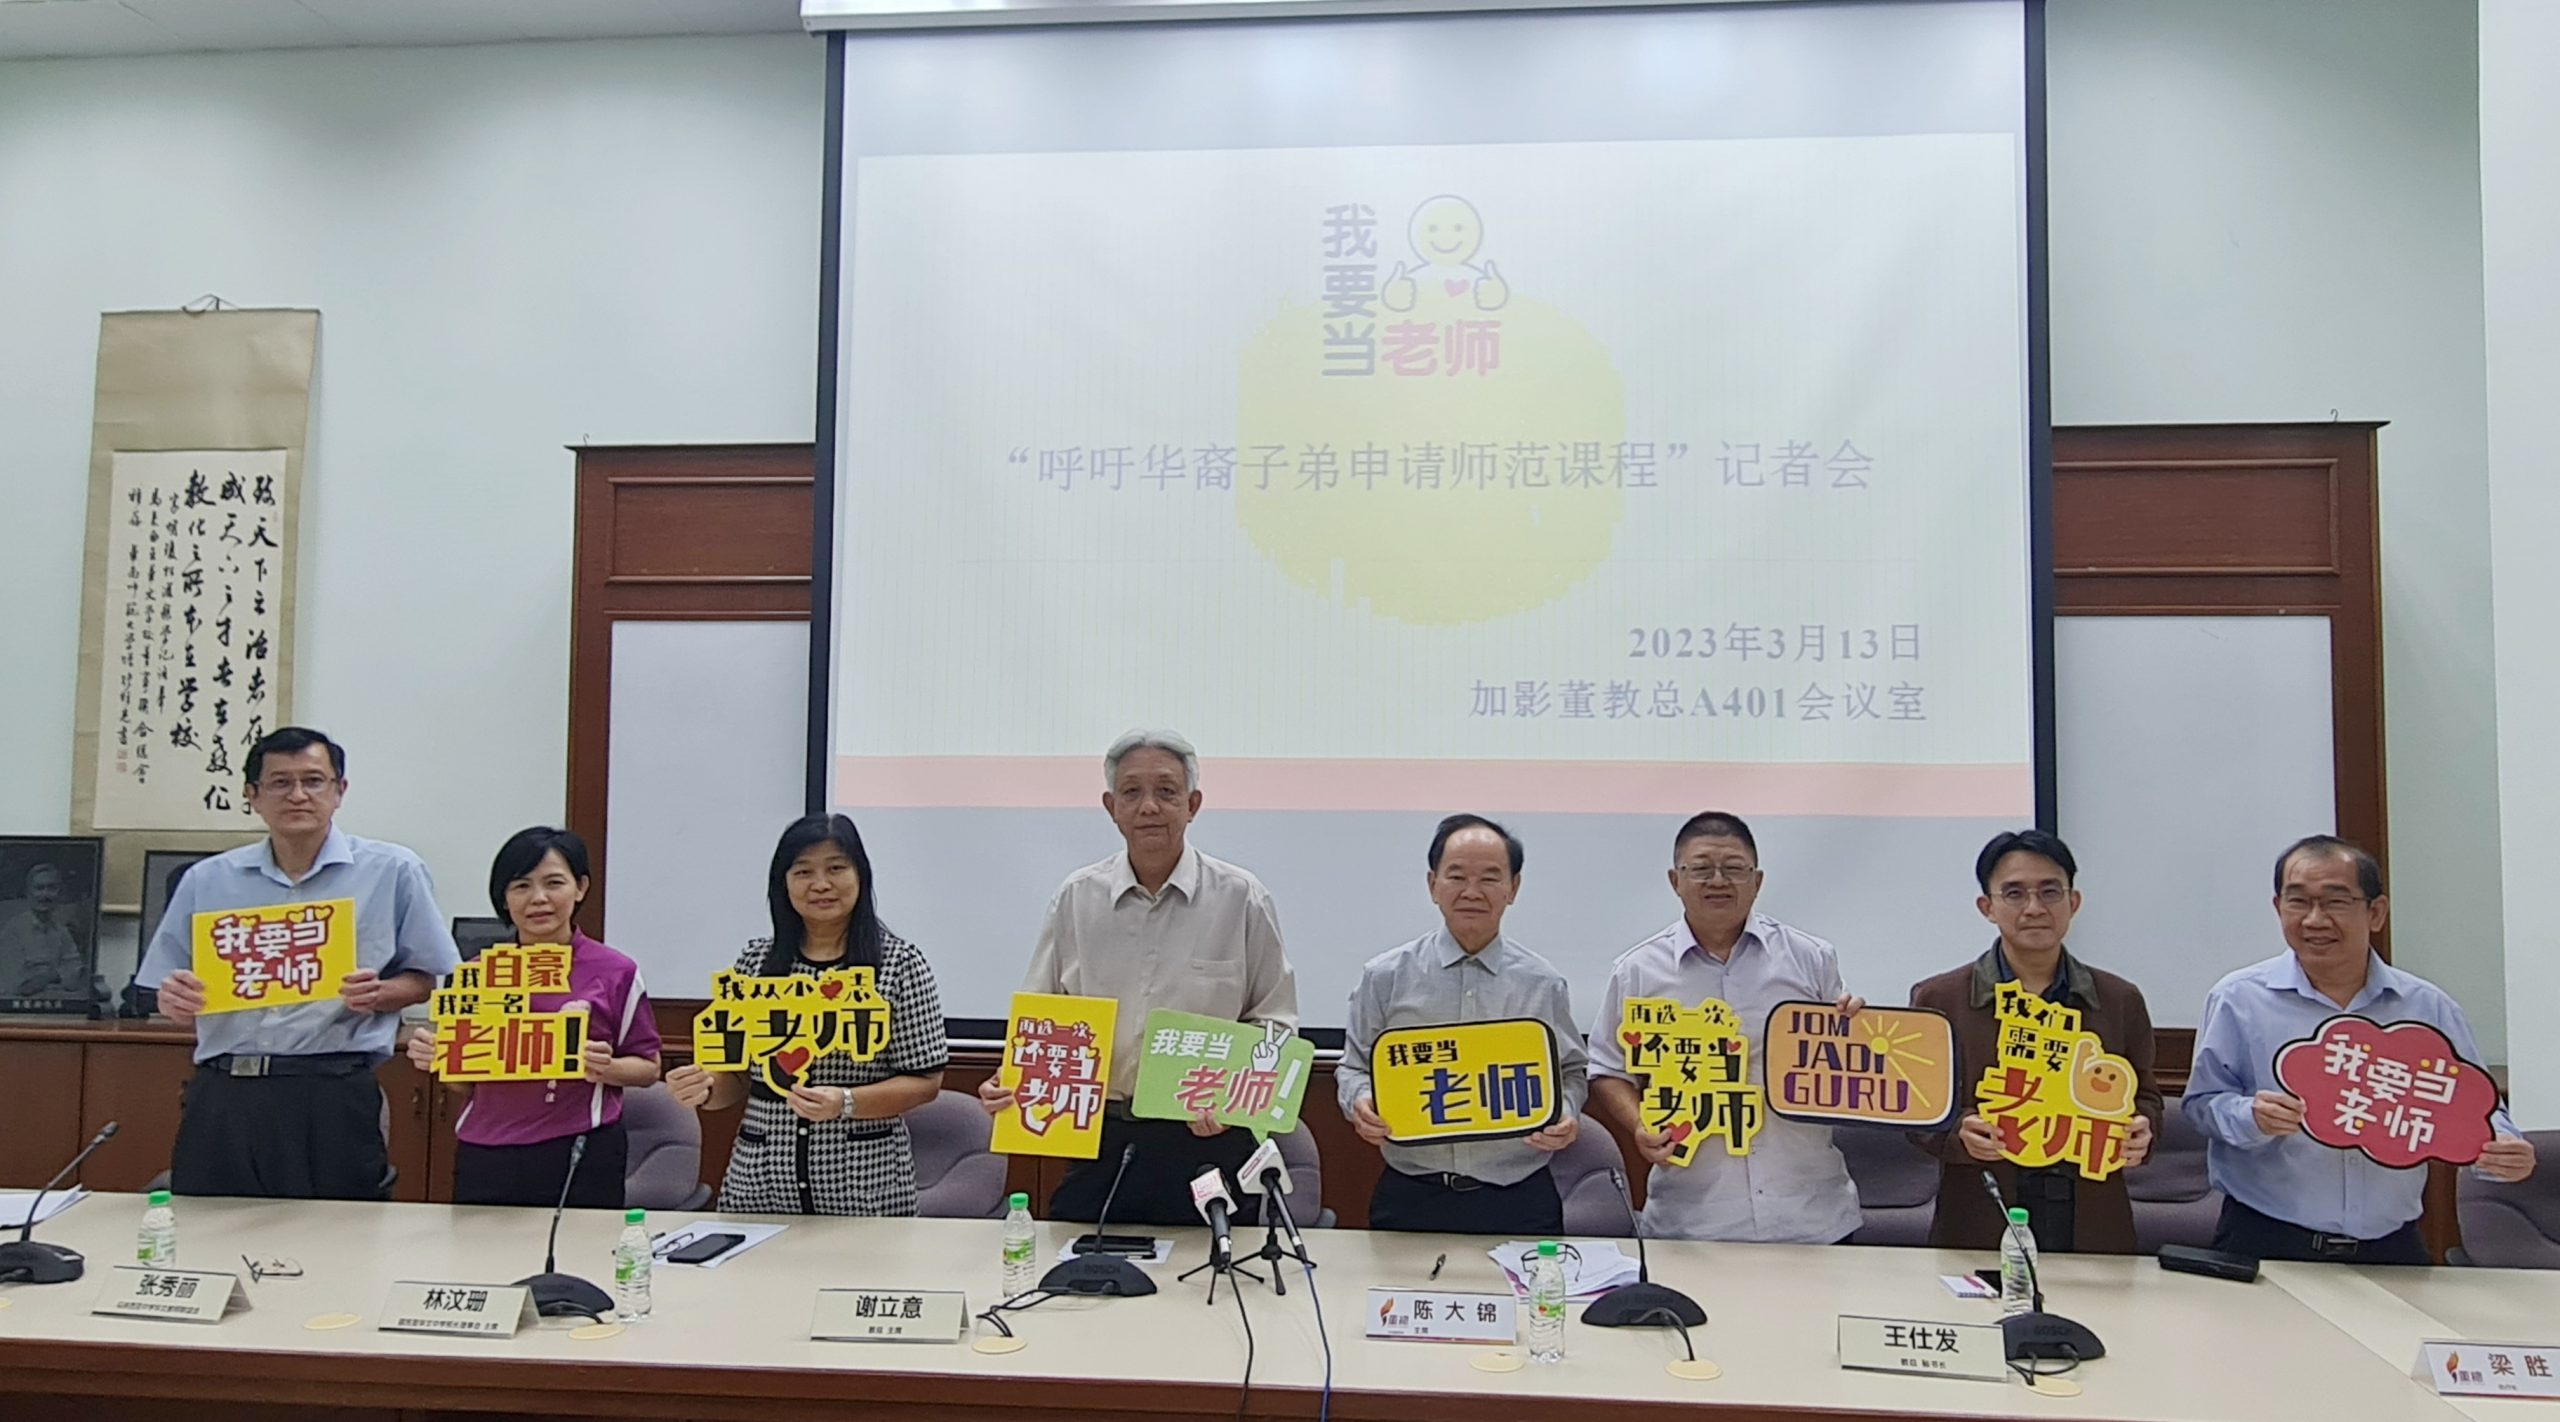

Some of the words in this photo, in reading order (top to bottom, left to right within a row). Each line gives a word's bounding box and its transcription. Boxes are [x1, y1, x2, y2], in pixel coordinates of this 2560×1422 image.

[1321, 203, 1378, 376] 我要当
[1381, 319, 1502, 376] 老师
[1628, 622, 1921, 662] 2023年3月13日
[1469, 679, 1928, 721] 加影董教总A401会议室
[213, 907, 332, 960] 我要当
[235, 953, 320, 997] 老师
[438, 993, 524, 1016] 我是一名
[1787, 1011, 1851, 1037] JOM
[2001, 989, 2075, 1032] 我们
[437, 1017, 582, 1075] 老师！
[699, 1008, 886, 1088] 当老师
[1012, 1038, 1098, 1080] 还要当
[1150, 1028, 1235, 1061] 我要当
[1386, 1039, 1459, 1068] 我要当
[1622, 1031, 1742, 1084] 还要当
[2005, 1025, 2071, 1073] 需要
[2323, 1033, 2459, 1105] 我要当
[1018, 1077, 1102, 1133] 老师
[1418, 1062, 1544, 1126] 老师
[1783, 1071, 1909, 1113] GURU
[1645, 1086, 1757, 1160] 老师
[1983, 1066, 2130, 1175] 老师
[2332, 1087, 2436, 1153] 老师
[136, 1273, 201, 1299] 张秀丽
[422, 1287, 489, 1313] 林汶珊
[855, 1294, 923, 1319] 谢立意
[1883, 1324, 1960, 1354] 王仕发
